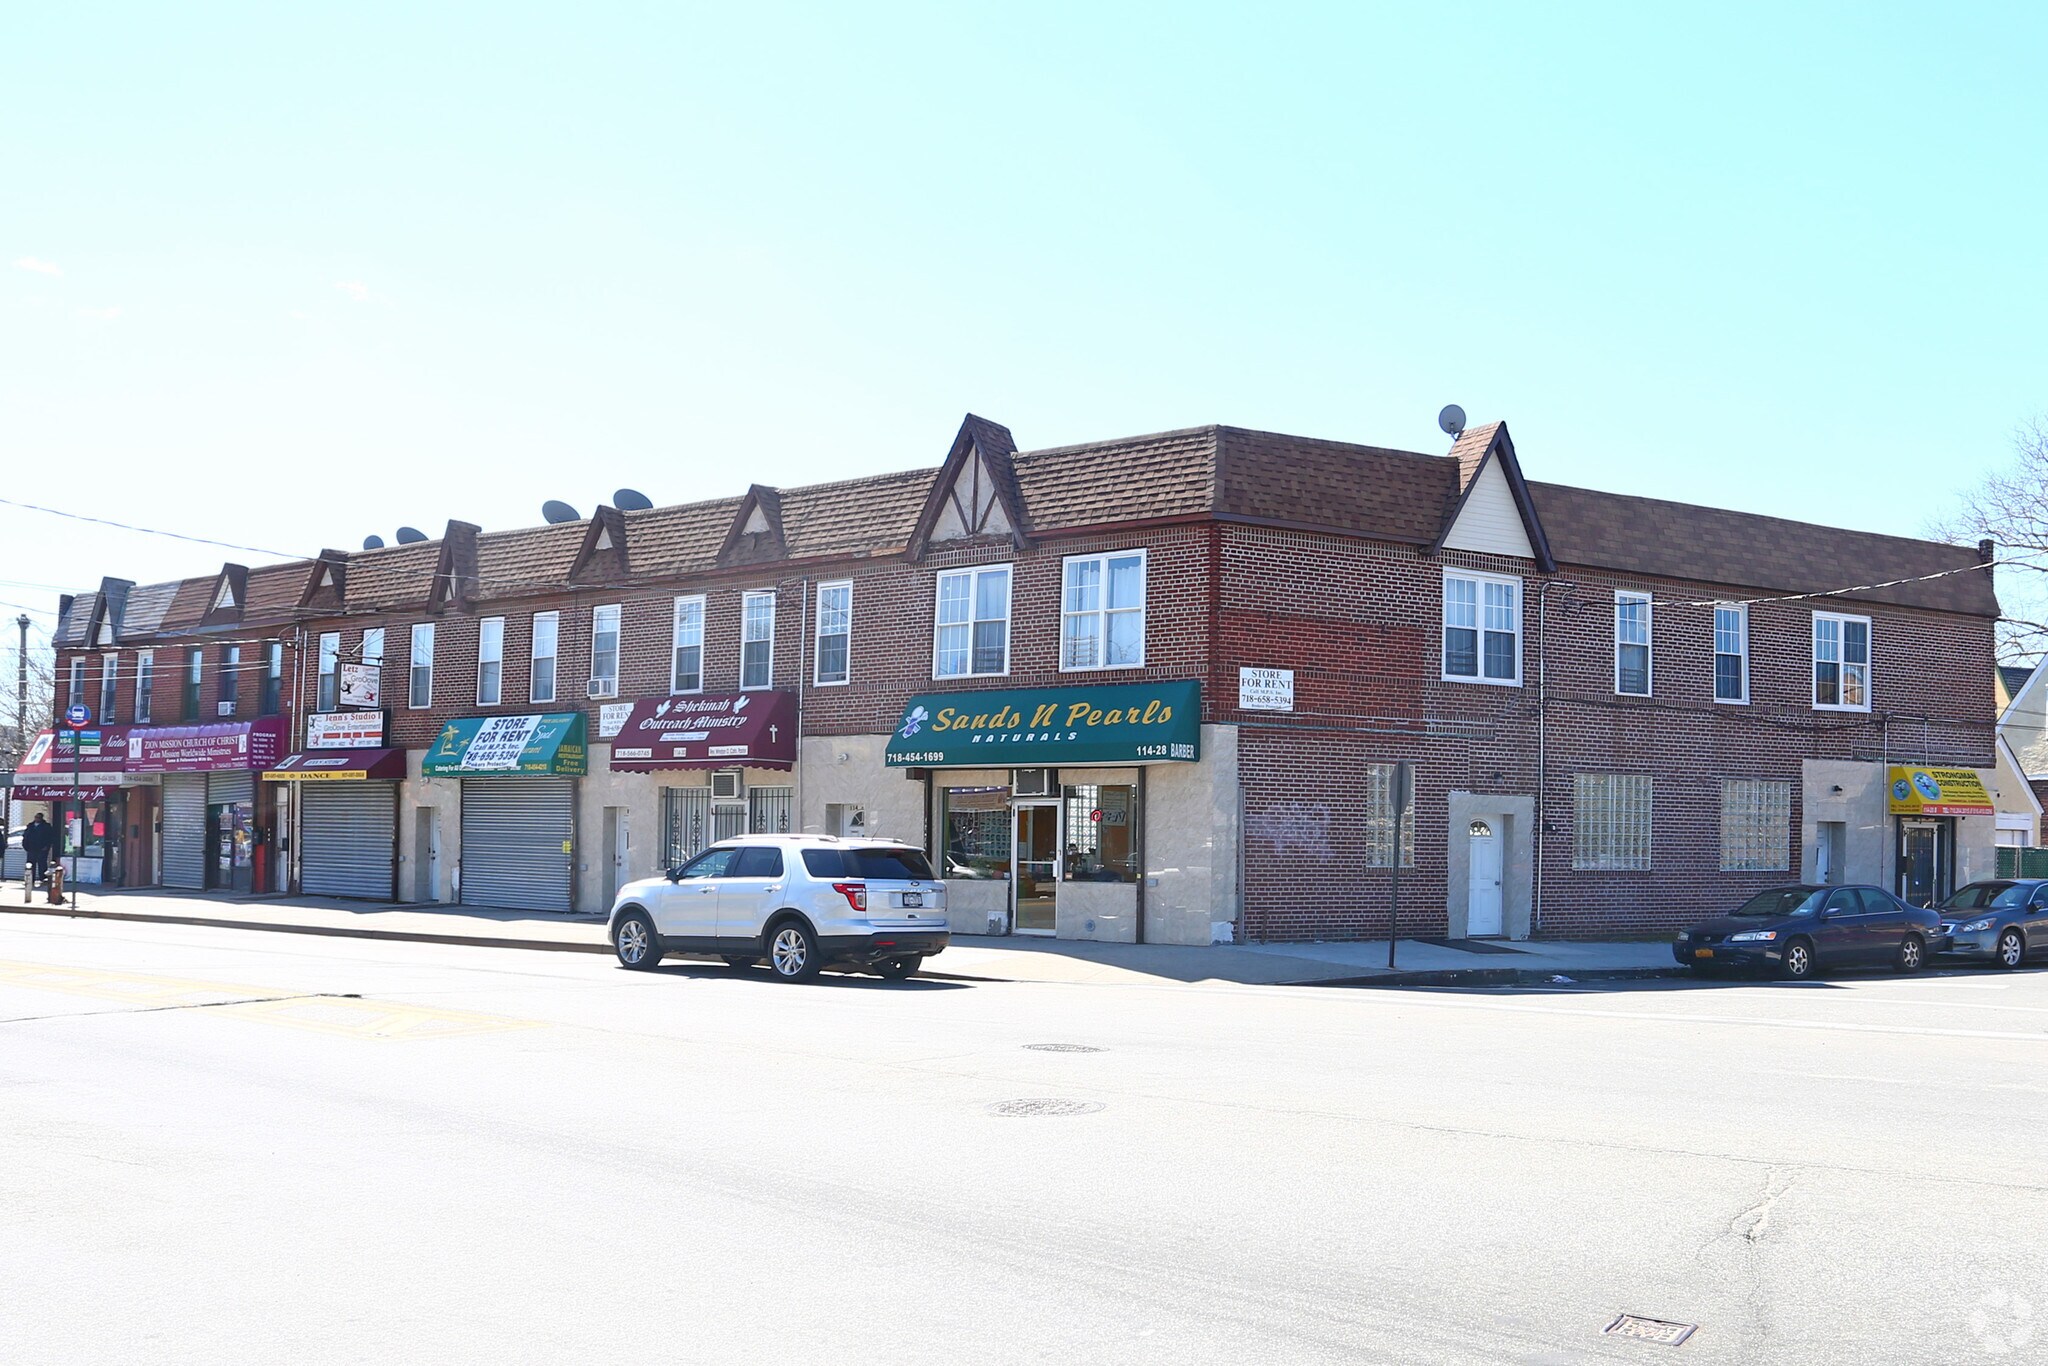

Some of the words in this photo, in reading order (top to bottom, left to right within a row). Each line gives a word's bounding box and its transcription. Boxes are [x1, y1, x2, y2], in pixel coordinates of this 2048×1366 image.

[343, 664, 359, 673] Letz
[1251, 670, 1283, 679] STORE
[1241, 678, 1262, 688] FOR
[1264, 679, 1293, 689] RENT
[1241, 694, 1292, 705] 718-658-5394
[671, 699, 731, 713] Shekinah
[325, 713, 348, 721] Jenn's
[350, 712, 376, 720] Studio
[616, 711, 631, 719] REN
[931, 704, 1021, 732] Sands
[1029, 703, 1060, 729] N
[1064, 699, 1173, 727] Pearls
[491, 718, 530, 730] STORE
[639, 717, 692, 730] Outreach
[688, 715, 748, 729] Ministry
[475, 731, 498, 743] FOR
[500, 730, 531, 742] RENT
[971, 731, 1079, 744] NATURALS
[145, 740, 158, 749] ZION
[159, 740, 182, 748] MISSION
[182, 739, 207, 747] CHURCH
[208, 738, 216, 746] OF
[217, 736, 238, 745] CHRIST
[150, 750, 161, 758] Zion
[162, 749, 180, 758] Mission
[180, 748, 206, 757] Worldwide
[207, 747, 231, 756] Ministries
[1136, 744, 1167, 756] 114-28
[1170, 743, 1195, 759] BARBER
[887, 752, 944, 763] 718-454-1699
[435, 764, 449, 772] Catering
[556, 766, 585, 774] Delivery
[1931, 771, 1978, 779] STRONGMAN
[1936, 779, 1983, 787] CONSTRUCTION
